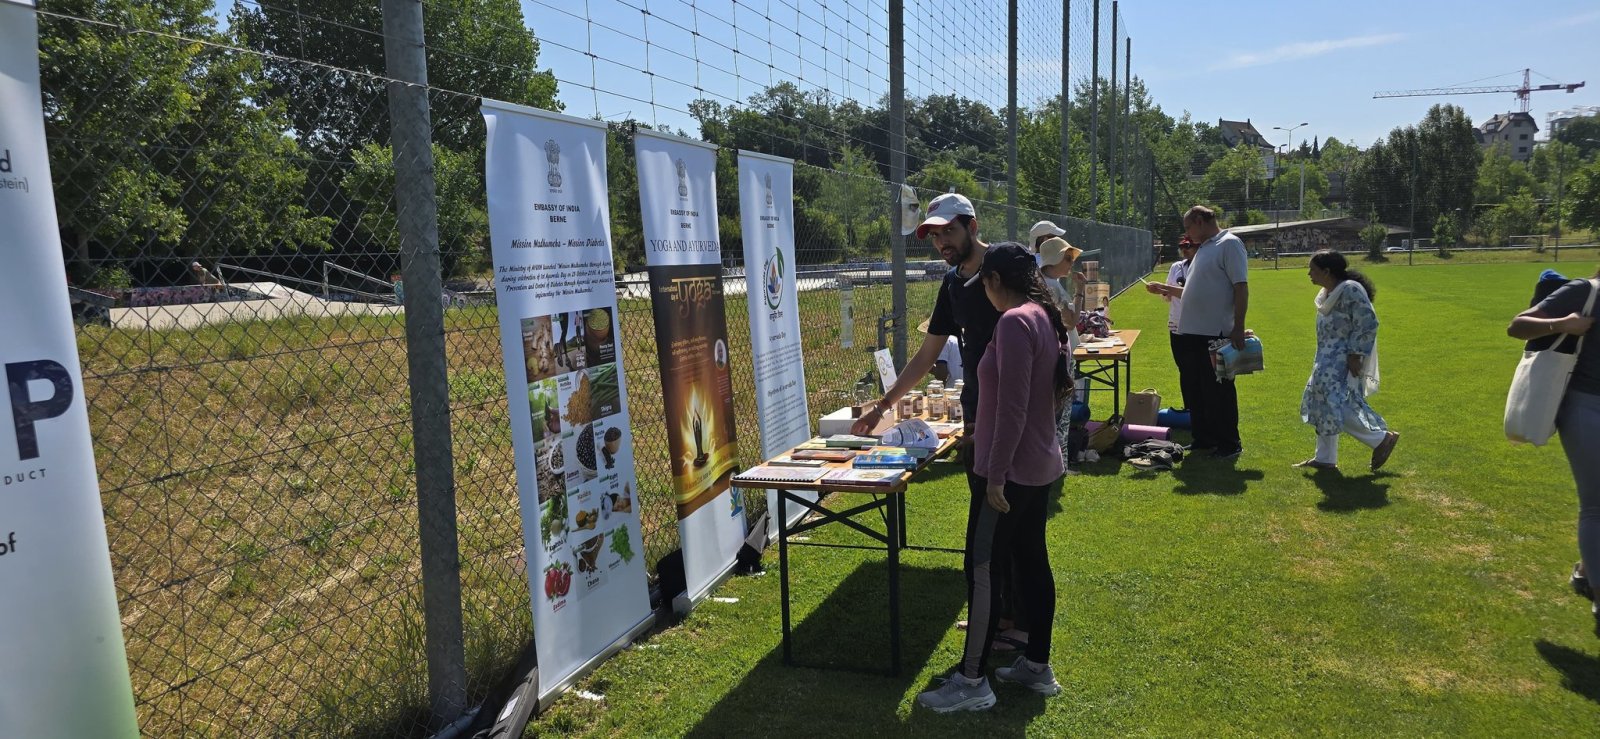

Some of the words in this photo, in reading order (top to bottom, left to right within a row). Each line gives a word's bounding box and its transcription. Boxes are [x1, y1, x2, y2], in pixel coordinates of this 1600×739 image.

[534, 203, 557, 212] EMBASSY
[559, 204, 565, 212] OF
[550, 215, 567, 223] BERNE
[511, 240, 532, 249] Mission
[567, 239, 585, 248] Mission
[586, 238, 605, 247] Diabetes
[650, 239, 672, 252] YOGA
[673, 240, 687, 252] AND
[688, 240, 720, 252] AYURVEDA
[5, 359, 74, 461] P
[4, 468, 47, 485] DUCT
